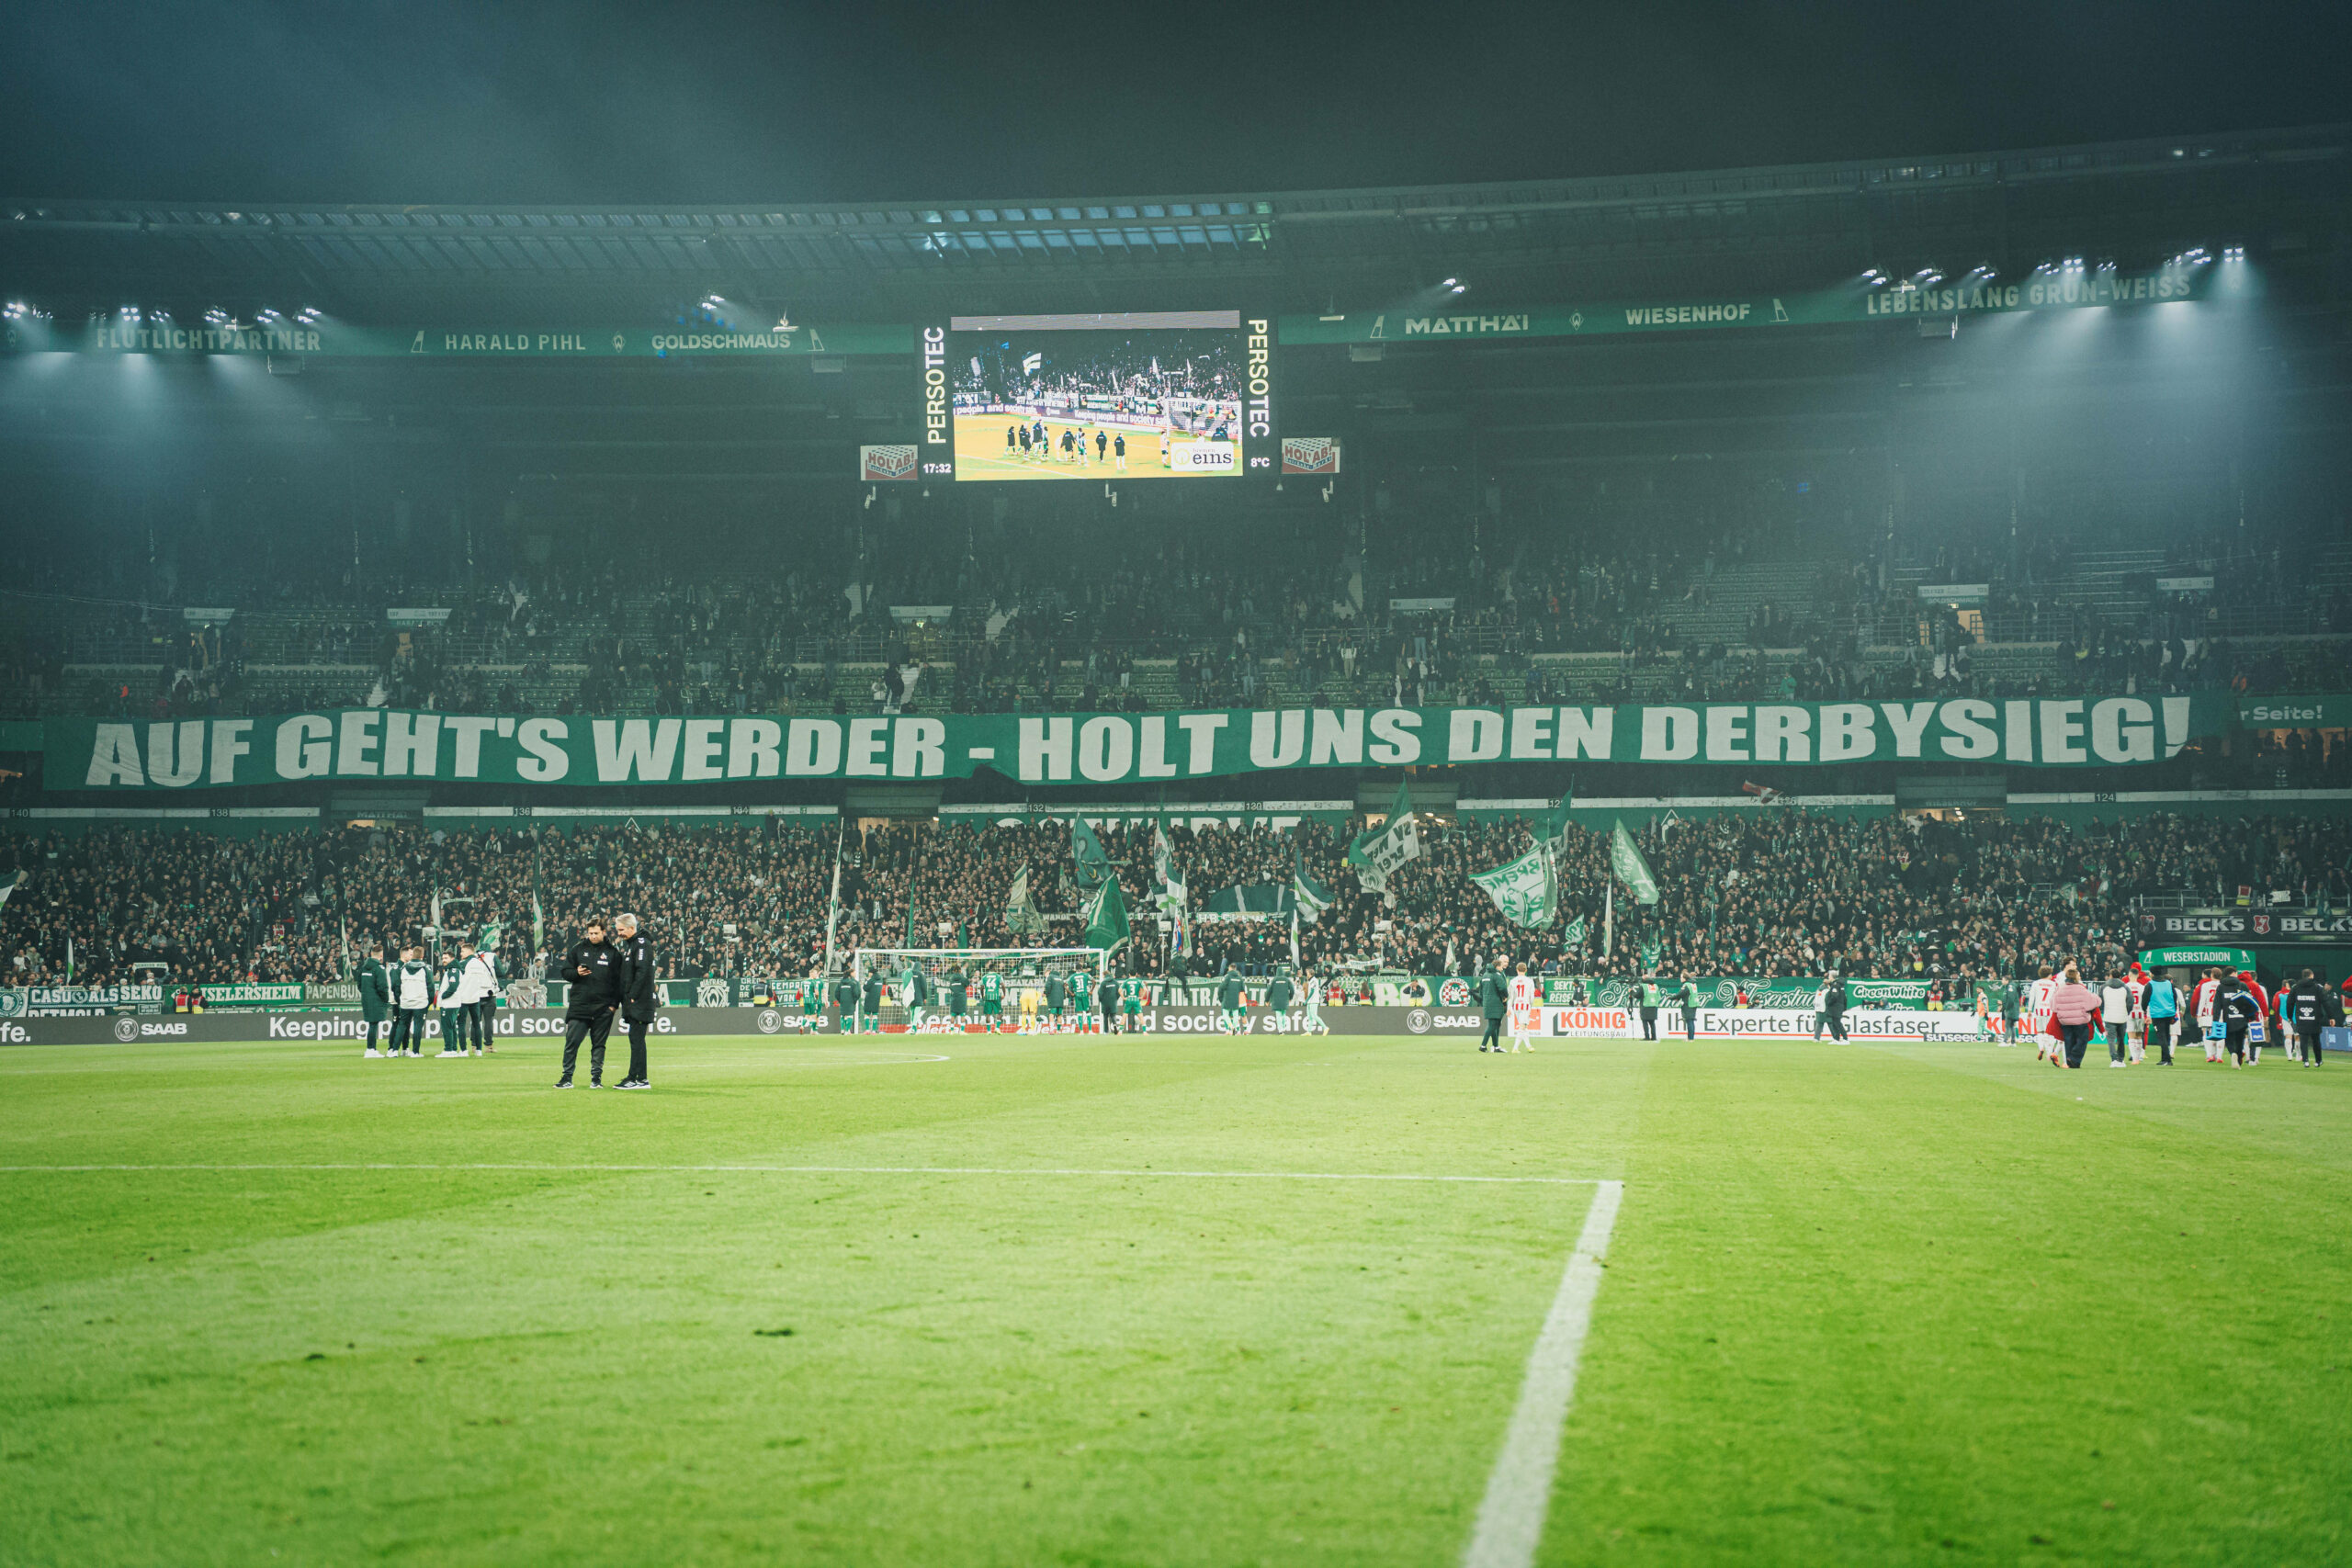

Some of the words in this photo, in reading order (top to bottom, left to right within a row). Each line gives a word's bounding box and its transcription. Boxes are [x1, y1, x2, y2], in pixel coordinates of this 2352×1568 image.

[1868, 285, 2019, 314] LEBENSLANG
[2030, 276, 2191, 305] GRÜN-WEISS
[1625, 304, 1752, 326] WIESENHOF
[1405, 314, 1529, 334] MATTHÄI
[96, 328, 321, 351] FLUTLICHTPARTNER
[446, 334, 530, 351] HARALD
[538, 334, 586, 351] PIHL
[651, 333, 791, 350] GOLDSCHMAUS
[923, 327, 945, 444] PERSOTEC
[1249, 320, 1270, 437] PERSOTEC
[1193, 453, 1232, 464] eins
[1250, 457, 1271, 468] 8°C
[923, 463, 952, 473] 17:32
[2253, 705, 2324, 721] Seite!
[85, 719, 254, 787] AUF
[277, 711, 570, 781] GEHT'S
[592, 718, 946, 782] WERDER
[969, 748, 995, 760] -
[1019, 714, 1229, 782] HOLT
[1250, 708, 1423, 768] UNS
[1448, 706, 1614, 762] DEN
[1640, 696, 2190, 763] DERBYSIEG!
[2096, 792, 2115, 802] 124
[10, 808, 29, 818] 140
[210, 808, 230, 818] 138
[513, 807, 532, 817] 136
[2166, 916, 2245, 931] BECK'S
[2163, 952, 2231, 963] WESERSTADION
[1129, 984, 1136, 996] 3
[1516, 984, 1525, 998] 11
[2041, 987, 2050, 1002] 7
[1433, 1015, 1481, 1028] SAAB
[1561, 1008, 1626, 1029] KÖNIG
[1704, 1013, 1790, 1034] Experte
[1796, 1013, 1816, 1031] fü
[141, 1022, 187, 1035] SAAB
[1570, 1030, 1627, 1038] LEITUNGSBAU
